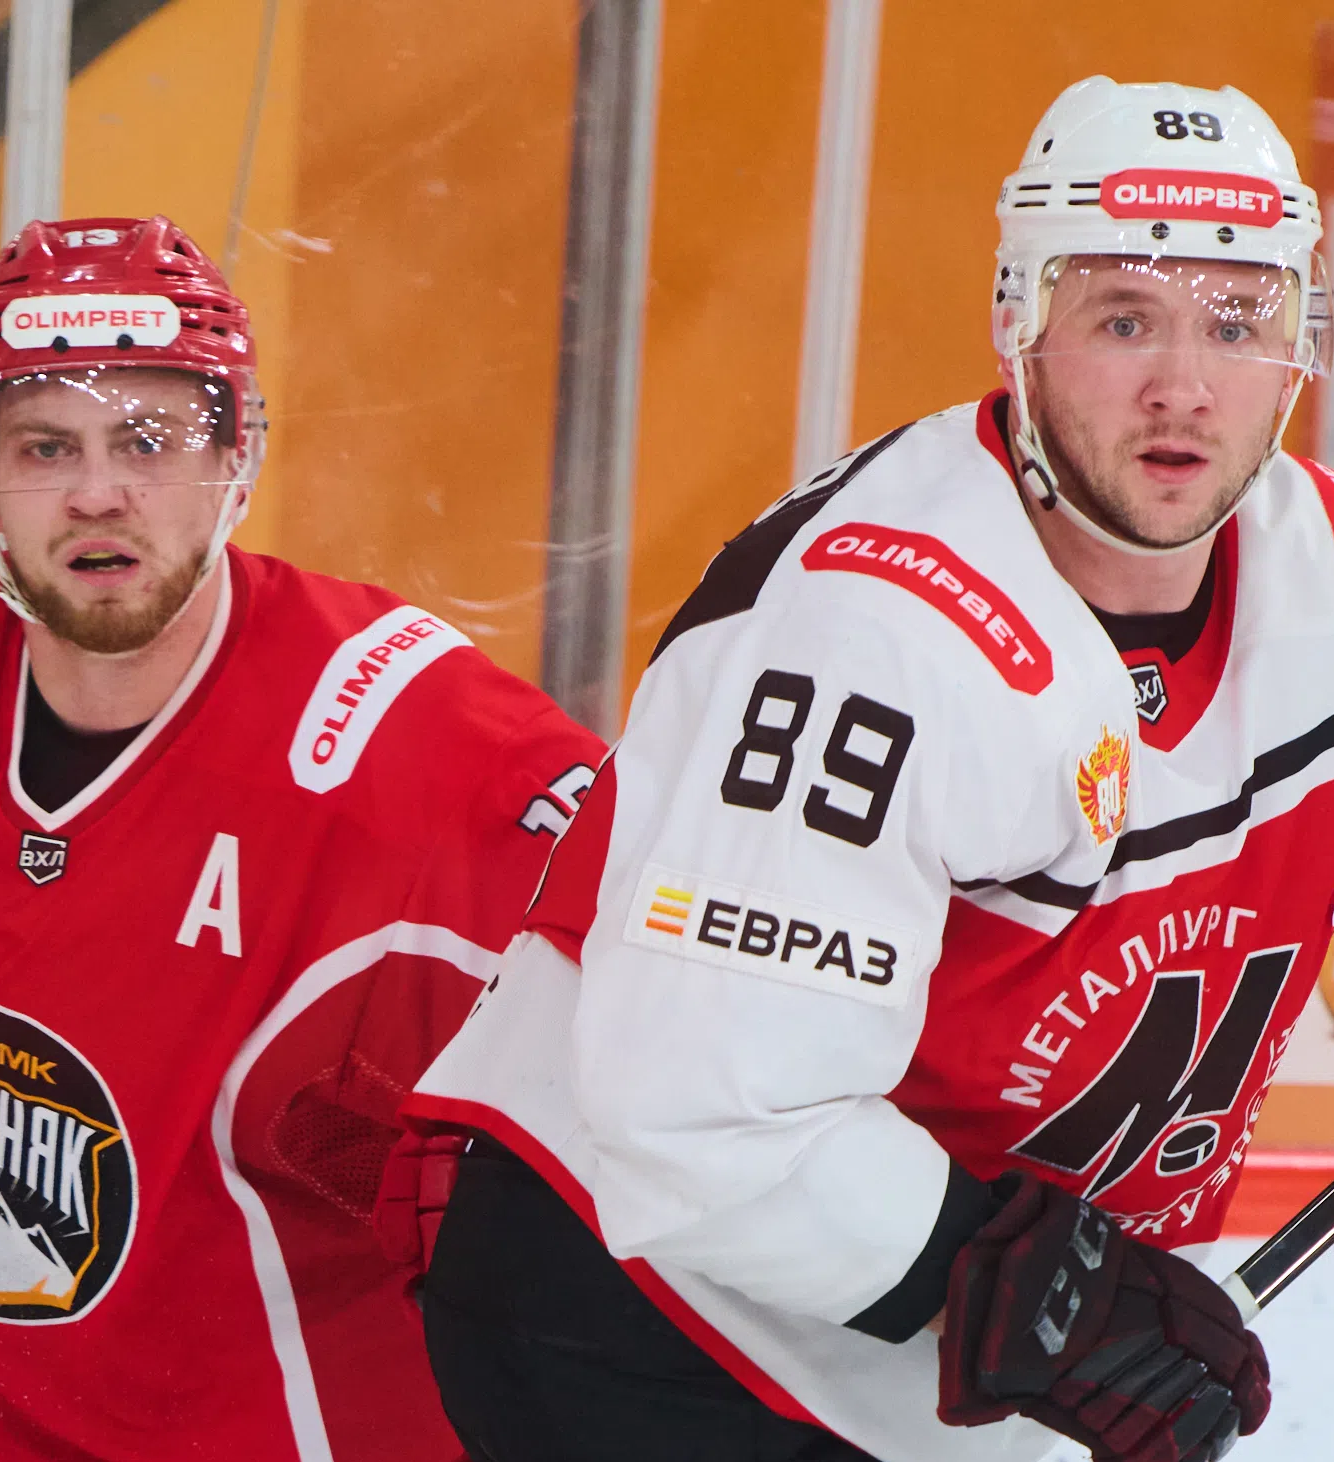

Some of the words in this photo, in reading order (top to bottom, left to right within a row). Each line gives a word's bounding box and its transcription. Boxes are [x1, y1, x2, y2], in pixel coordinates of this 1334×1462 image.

[1153, 110, 1224, 142] 89
[1113, 183, 1275, 214] OLIMPBET
[65, 228, 120, 249] 13
[14, 310, 167, 330] OLIMPBET
[826, 535, 1036, 667] OLIMPBET
[311, 617, 446, 765] OLIMPBET
[720, 668, 915, 848] 89
[1097, 770, 1121, 828] 80
[19, 849, 66, 868] ВХЛ
[696, 898, 898, 987] ЕВРАЗ
[1000, 906, 1257, 1109] МЕТАЛЛУРГ
